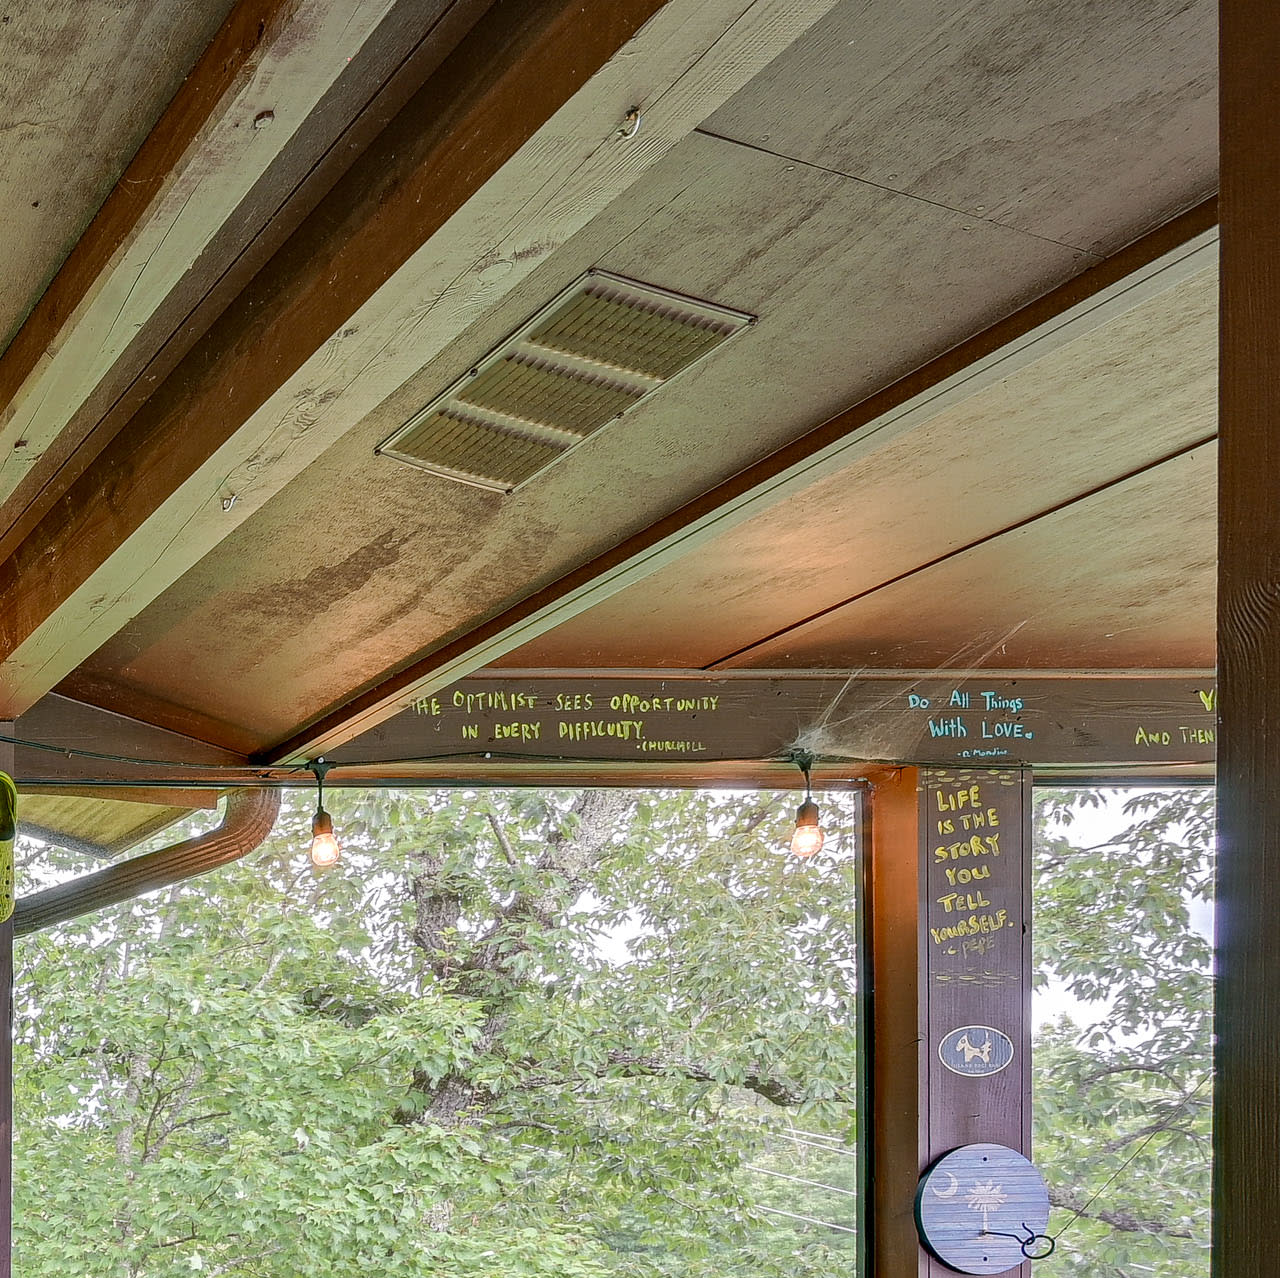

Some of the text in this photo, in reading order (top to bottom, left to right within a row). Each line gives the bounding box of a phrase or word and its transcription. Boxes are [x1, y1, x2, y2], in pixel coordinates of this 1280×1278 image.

[452, 690, 539, 714] OPTIMIST
[554, 693, 593, 712] SEES
[610, 693, 719, 715] OPPORTUNITY
[908, 689, 1023, 714] Do All Things
[461, 720, 646, 744] IN EVERY DIFFICULTY.
[928, 716, 967, 738] With
[1135, 726, 1215, 747] AND THEN
[936, 785, 982, 812] LIFE
[937, 808, 1000, 836] IS THE
[934, 832, 1000, 864] STORY
[945, 864, 991, 886] YOU
[936, 890, 991, 913] TELL
[930, 909, 1014, 945] YOURSELF.
